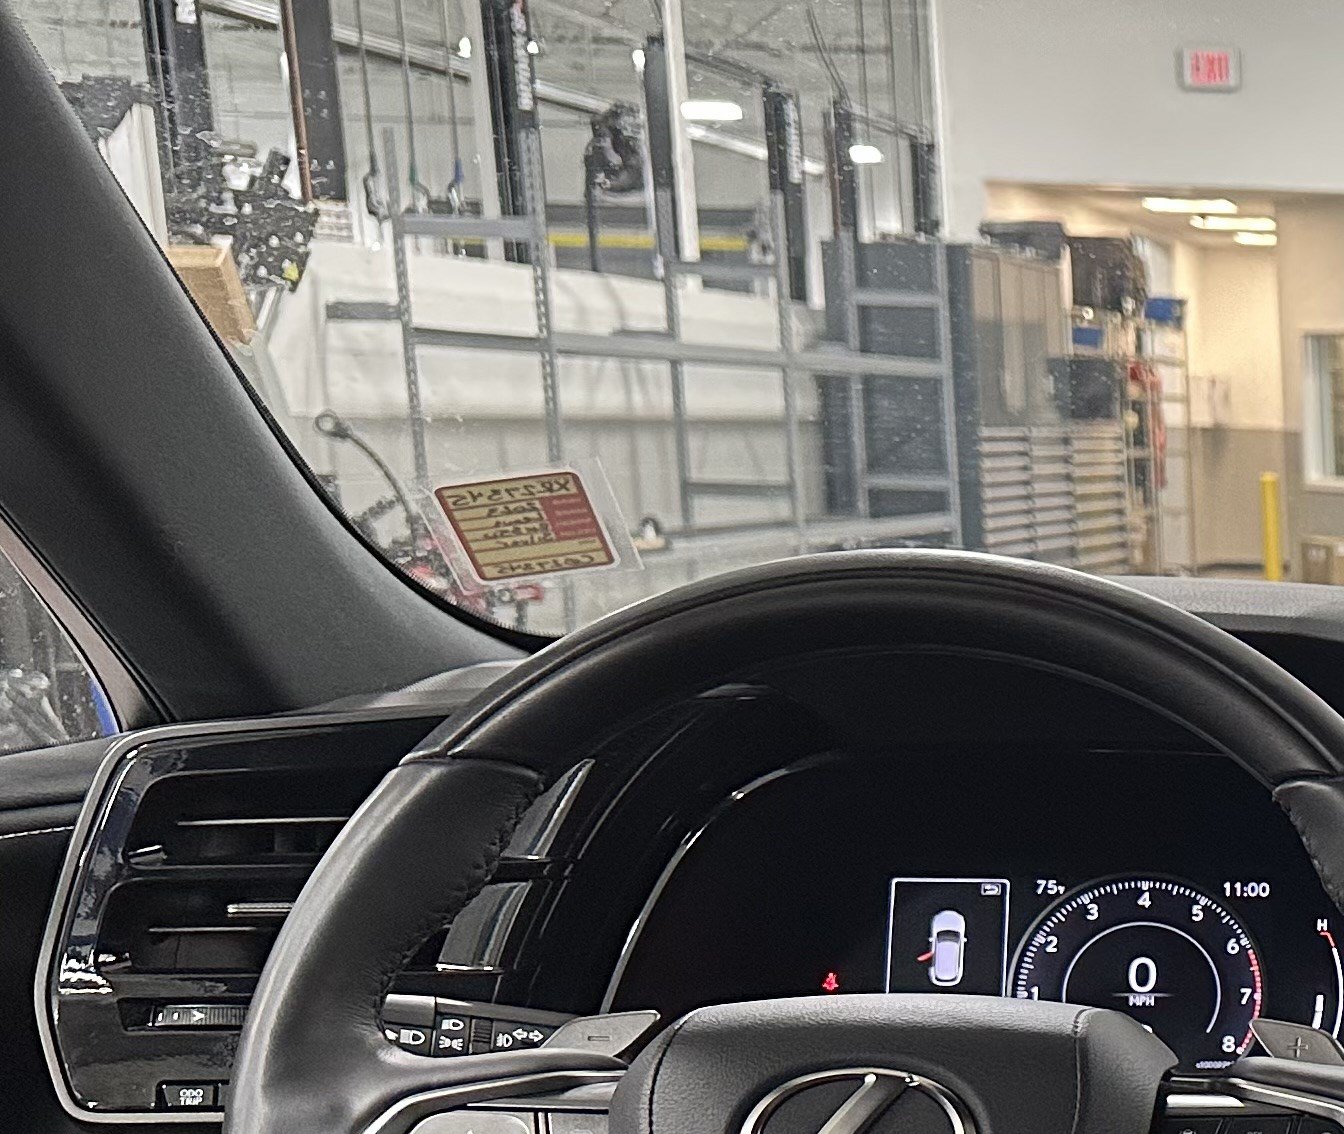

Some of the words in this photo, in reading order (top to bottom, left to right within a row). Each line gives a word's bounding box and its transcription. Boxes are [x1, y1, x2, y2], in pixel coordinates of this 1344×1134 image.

[1191, 52, 1229, 84] EXIT
[1223, 882, 1270, 898] 11:00
[1137, 892, 1151, 909] 4
[1086, 903, 1099, 921] 3
[1191, 904, 1204, 922] 5
[1316, 919, 1328, 932] H
[1045, 935, 1058, 953] 2
[1226, 938, 1240, 955] 6
[1128, 956, 1157, 993] 0
[1128, 993, 1156, 1007] MPH
[1240, 988, 1252, 1005] 7
[1222, 1035, 1236, 1053] 8
[180, 1088, 204, 1097] ODO
[180, 1096, 203, 1106] TRIP
